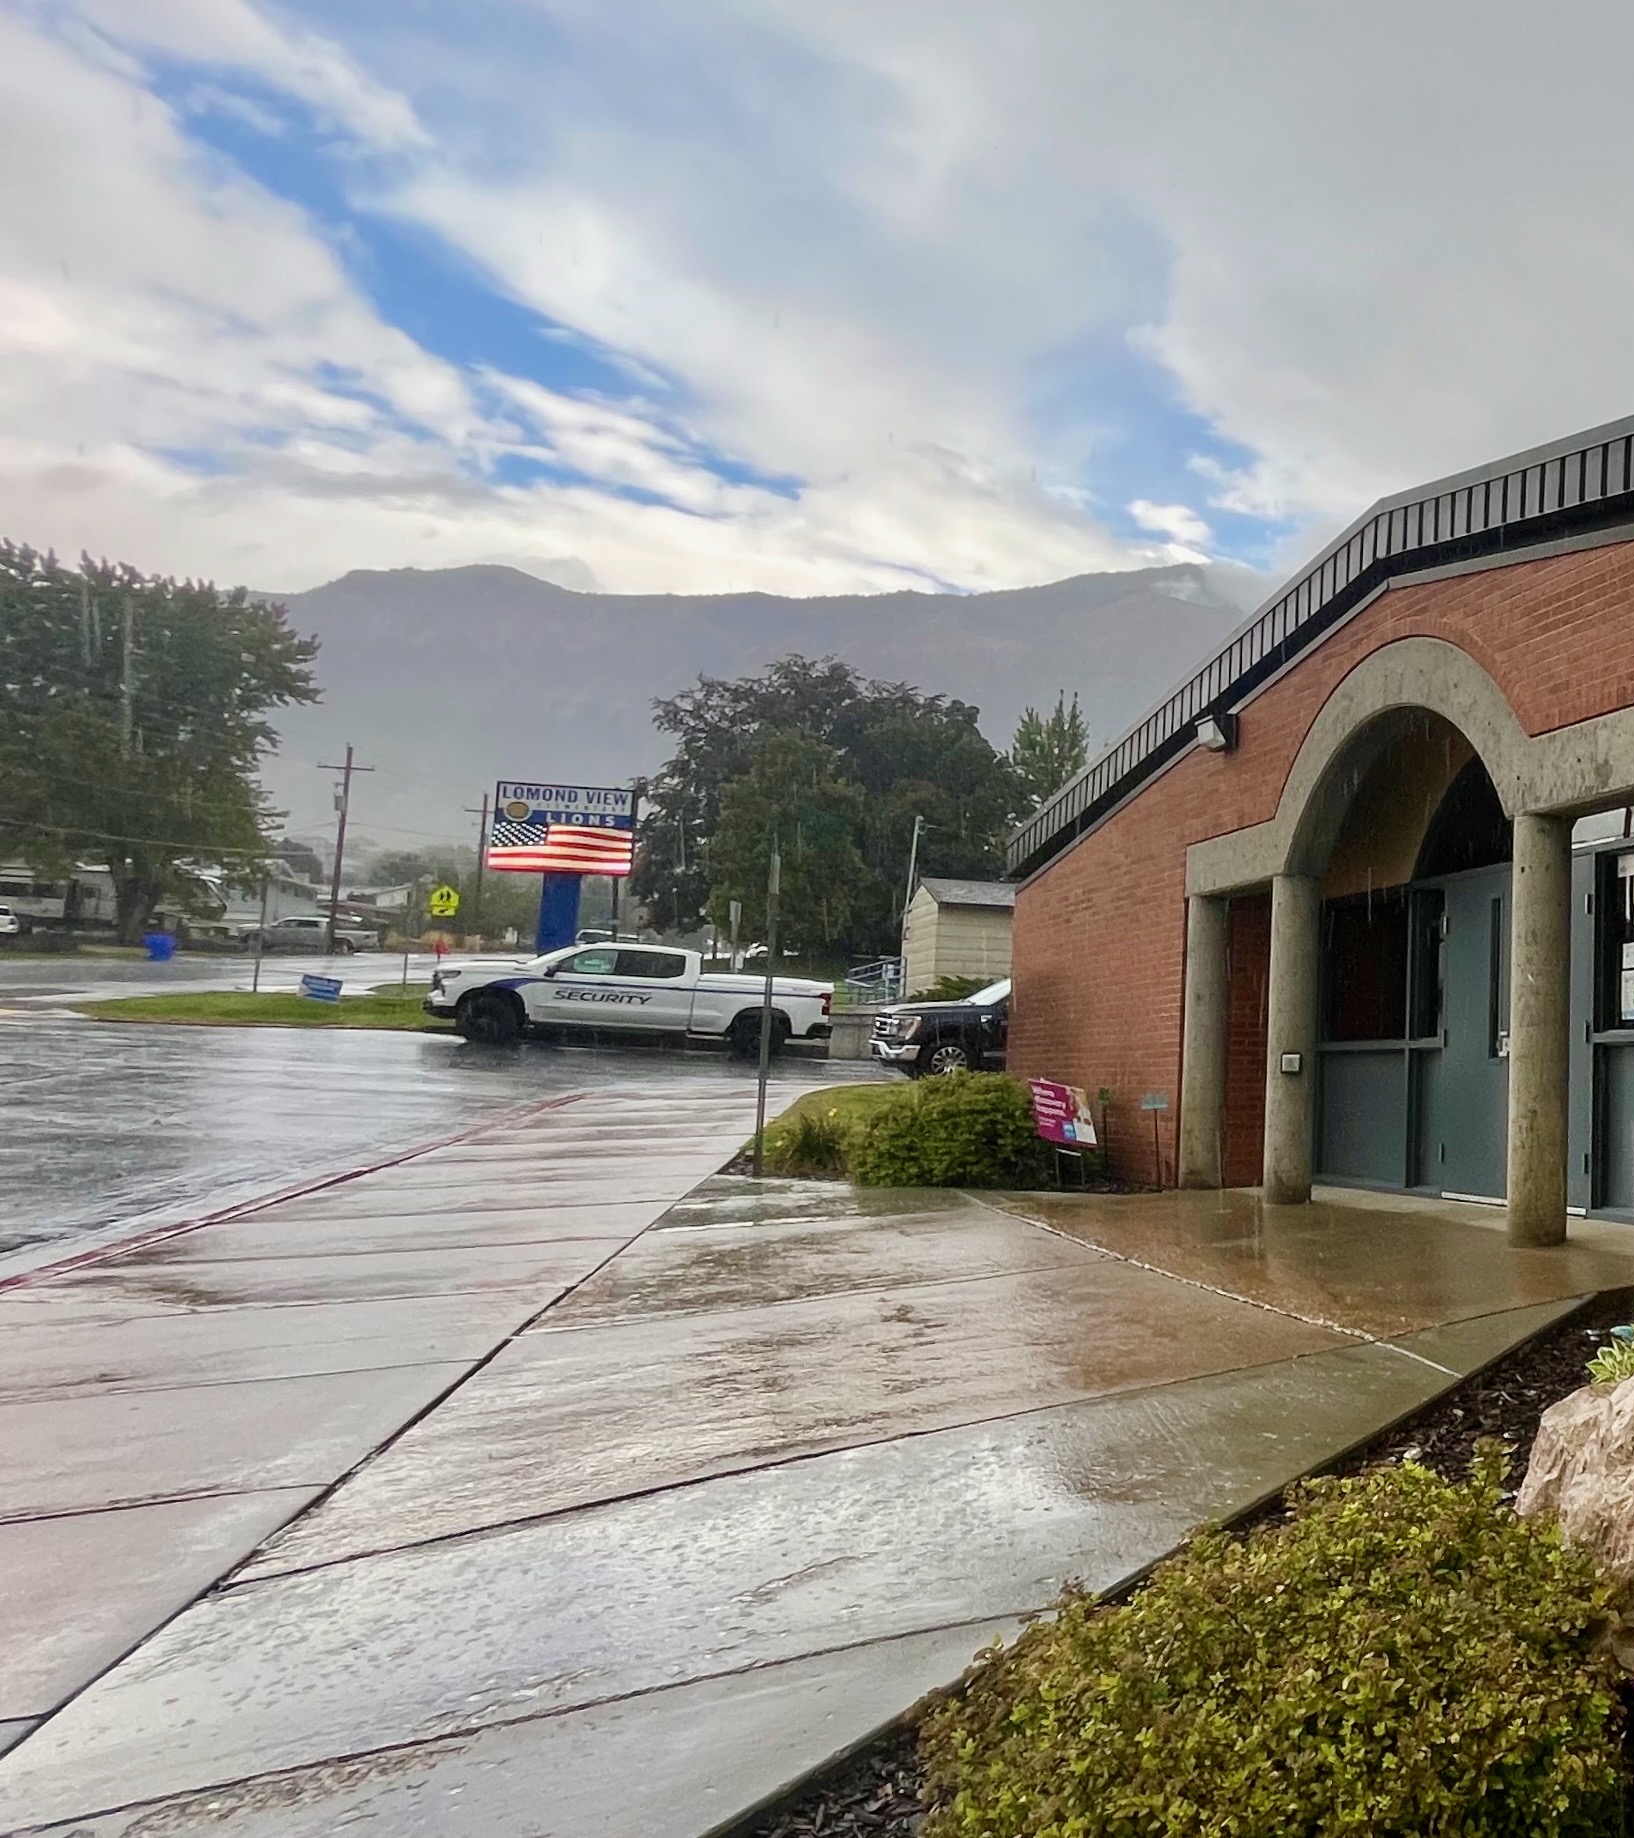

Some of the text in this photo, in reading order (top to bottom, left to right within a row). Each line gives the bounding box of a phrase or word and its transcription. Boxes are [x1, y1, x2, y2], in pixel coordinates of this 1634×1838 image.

[502, 786, 628, 806] LOMOND VIEW
[546, 812, 616, 827] LIONS
[553, 990, 653, 1005] SECURITY
